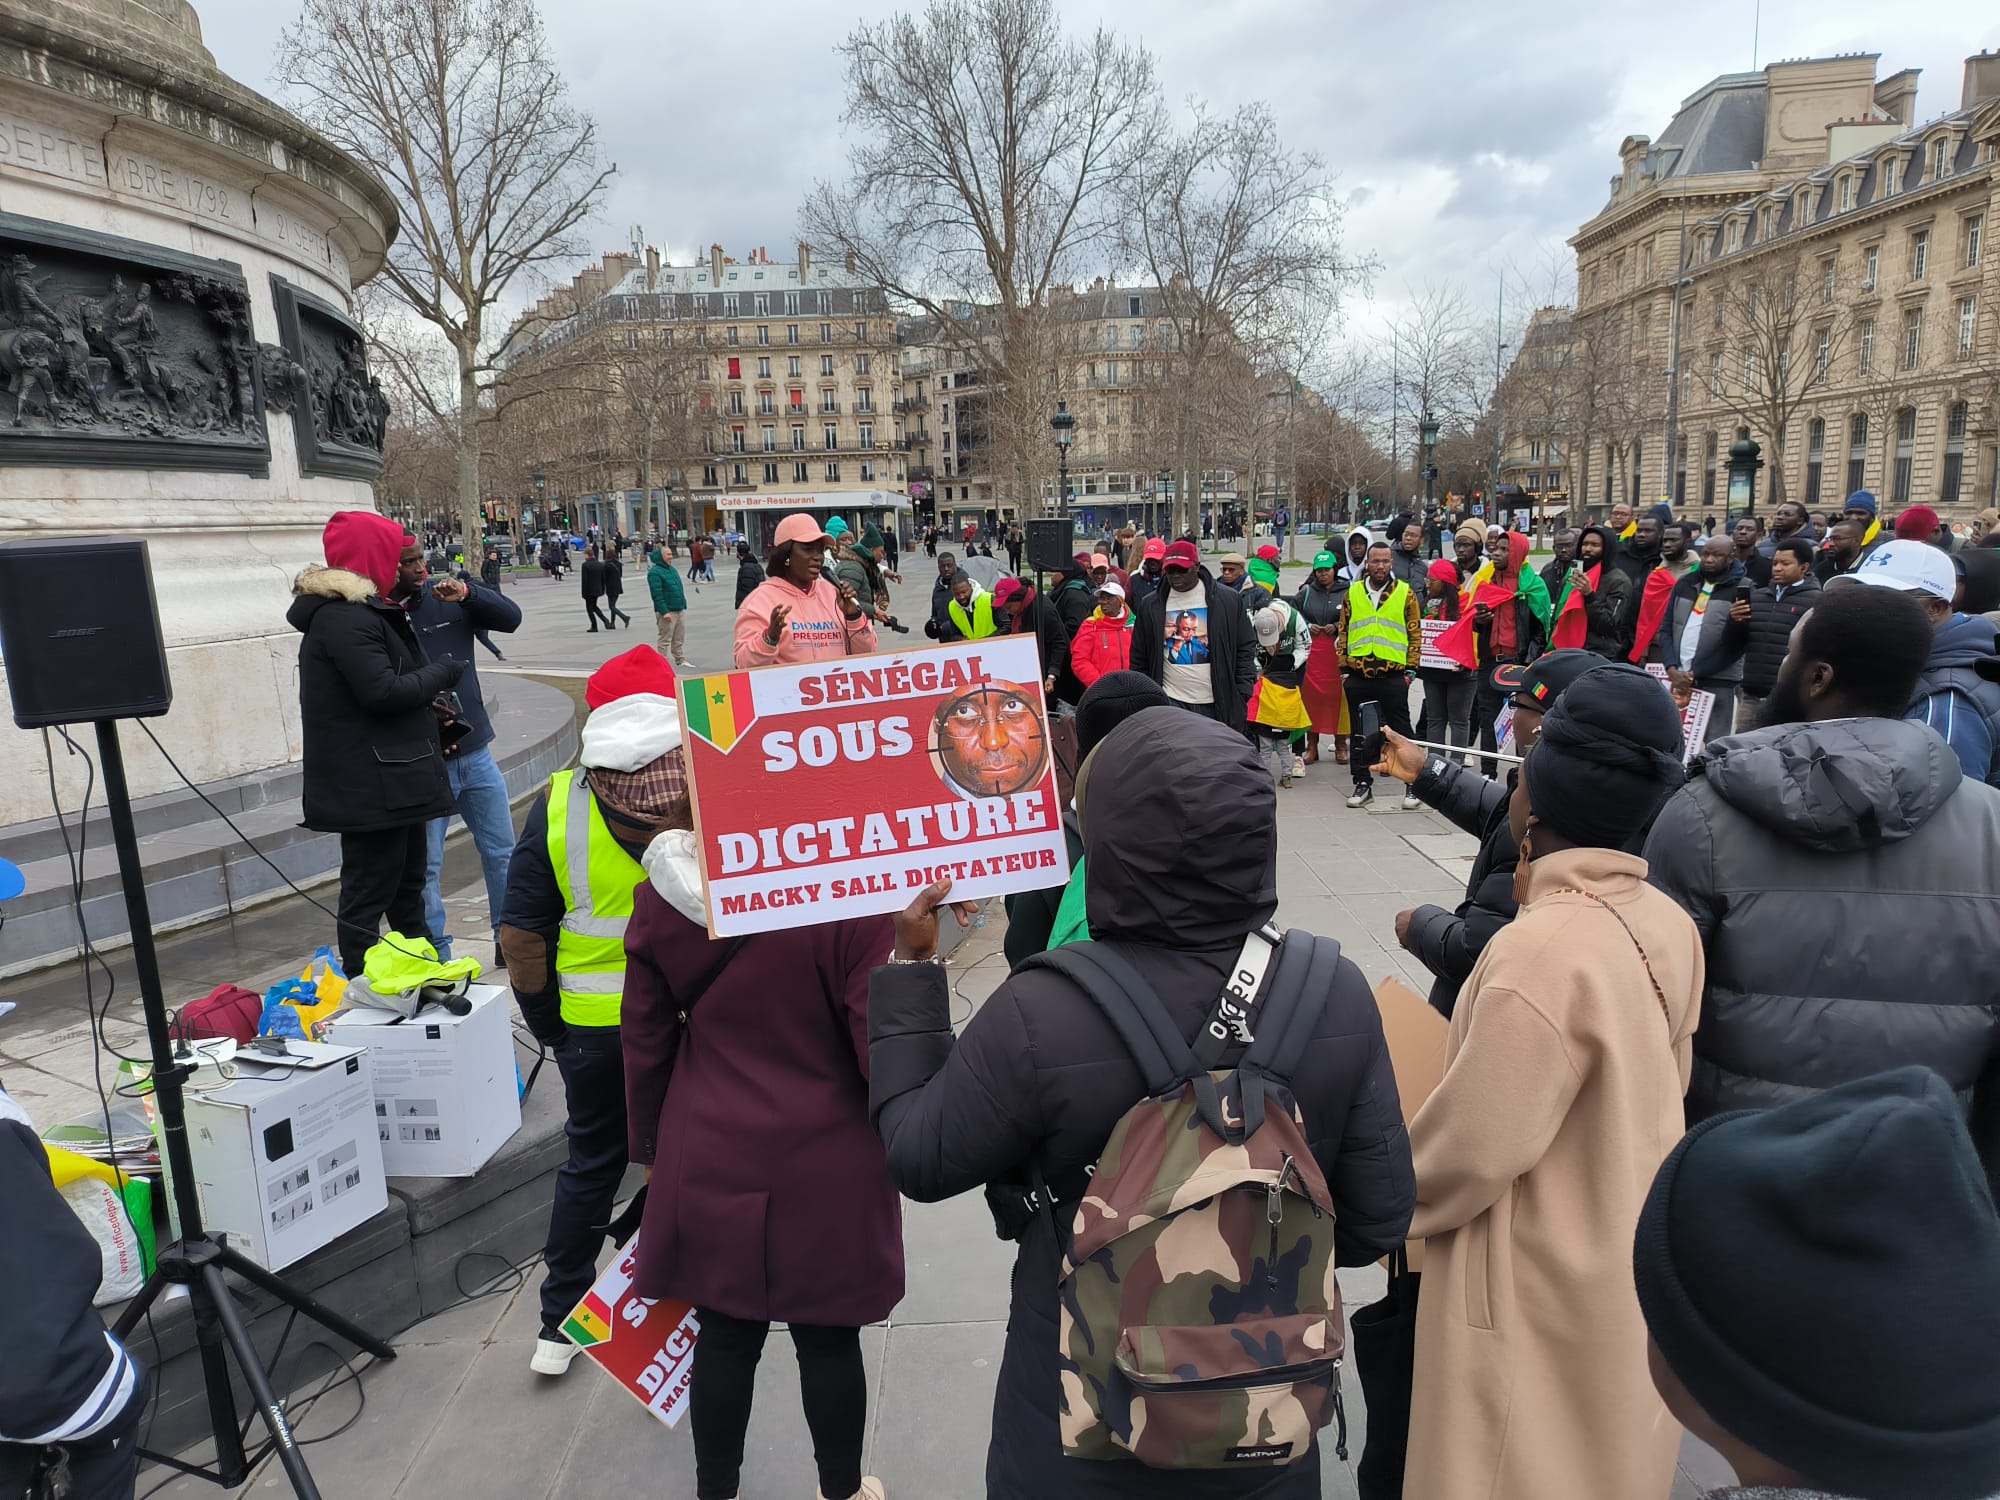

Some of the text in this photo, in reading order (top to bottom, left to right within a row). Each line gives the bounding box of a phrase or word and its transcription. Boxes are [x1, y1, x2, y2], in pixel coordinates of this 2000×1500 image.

[184, 175, 230, 219] 1792
[799, 656, 992, 706] SÉNÉGAL
[761, 715, 914, 773] SOUS
[717, 790, 1047, 875] DICTATURE
[720, 849, 1057, 915] MACKY SALL DICTATEUR
[660, 1367, 693, 1413] MAC
